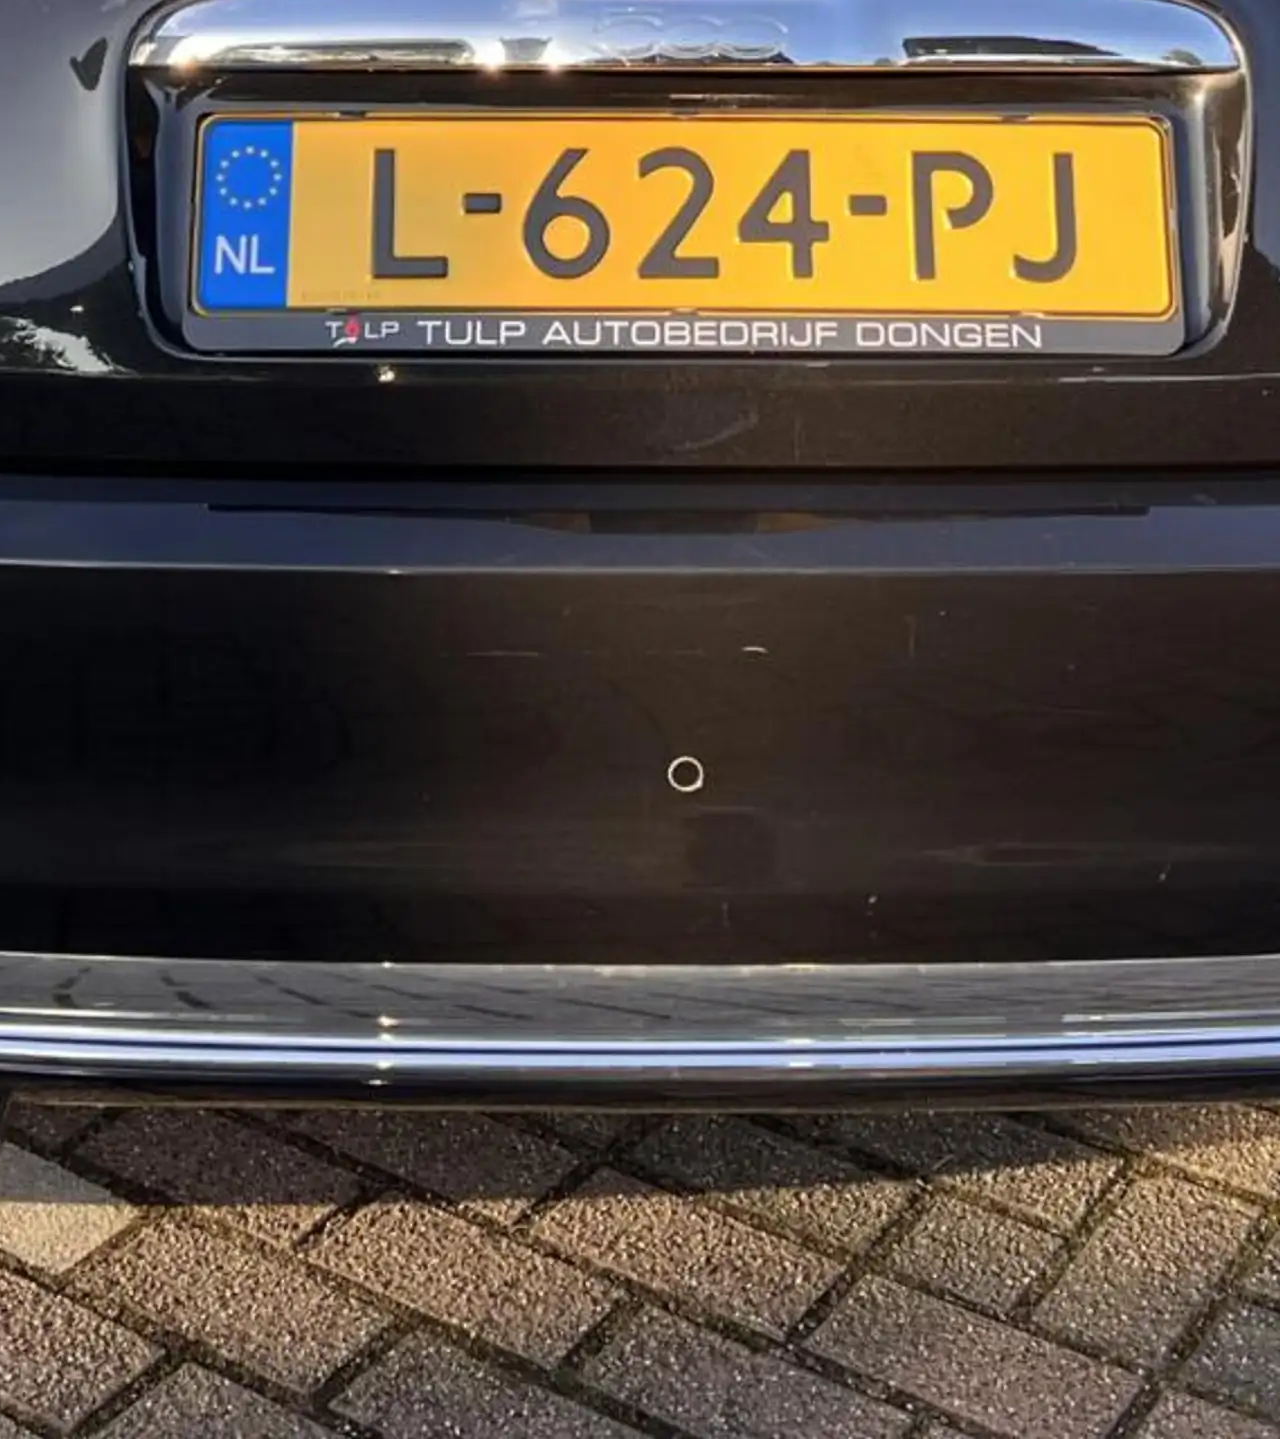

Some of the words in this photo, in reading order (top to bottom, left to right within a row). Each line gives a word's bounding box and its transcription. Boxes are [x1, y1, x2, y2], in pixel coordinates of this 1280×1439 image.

[369, 146, 1078, 284] L-624-PJ
[214, 234, 276, 275] NL
[417, 319, 527, 346] TULP
[541, 320, 838, 348] AUTOBEDRIJF
[856, 321, 1043, 349] DONGEN
